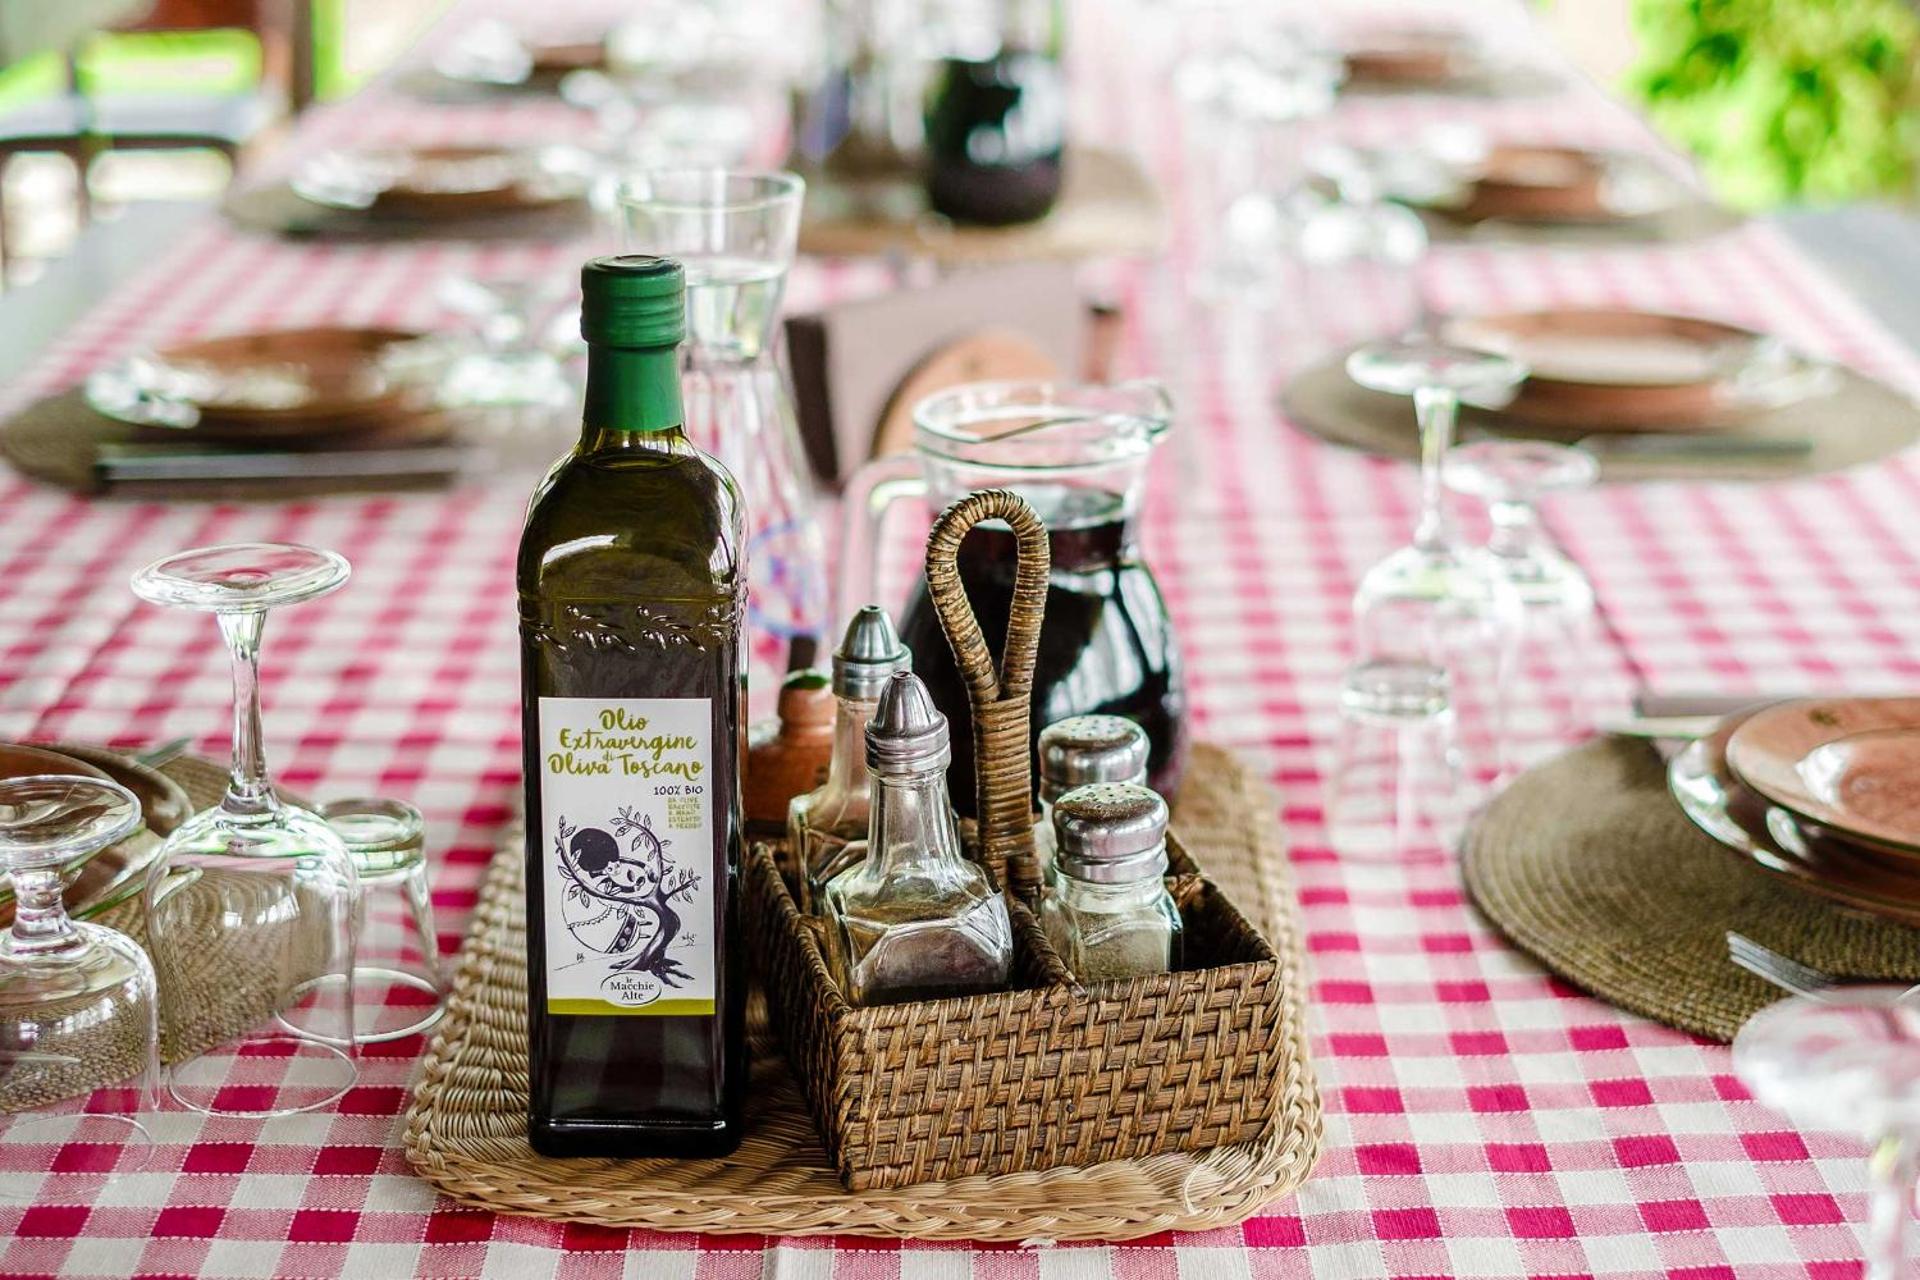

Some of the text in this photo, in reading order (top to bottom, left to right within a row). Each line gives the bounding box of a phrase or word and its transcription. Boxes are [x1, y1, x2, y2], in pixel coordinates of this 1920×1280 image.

[599, 707, 649, 731] Olio
[560, 728, 697, 760] Extravergine
[548, 752, 704, 781] Oliva Toscano
[653, 785, 704, 796] 100% BIO
[610, 981, 655, 991] Macchie
[622, 991, 644, 1000] Alte
